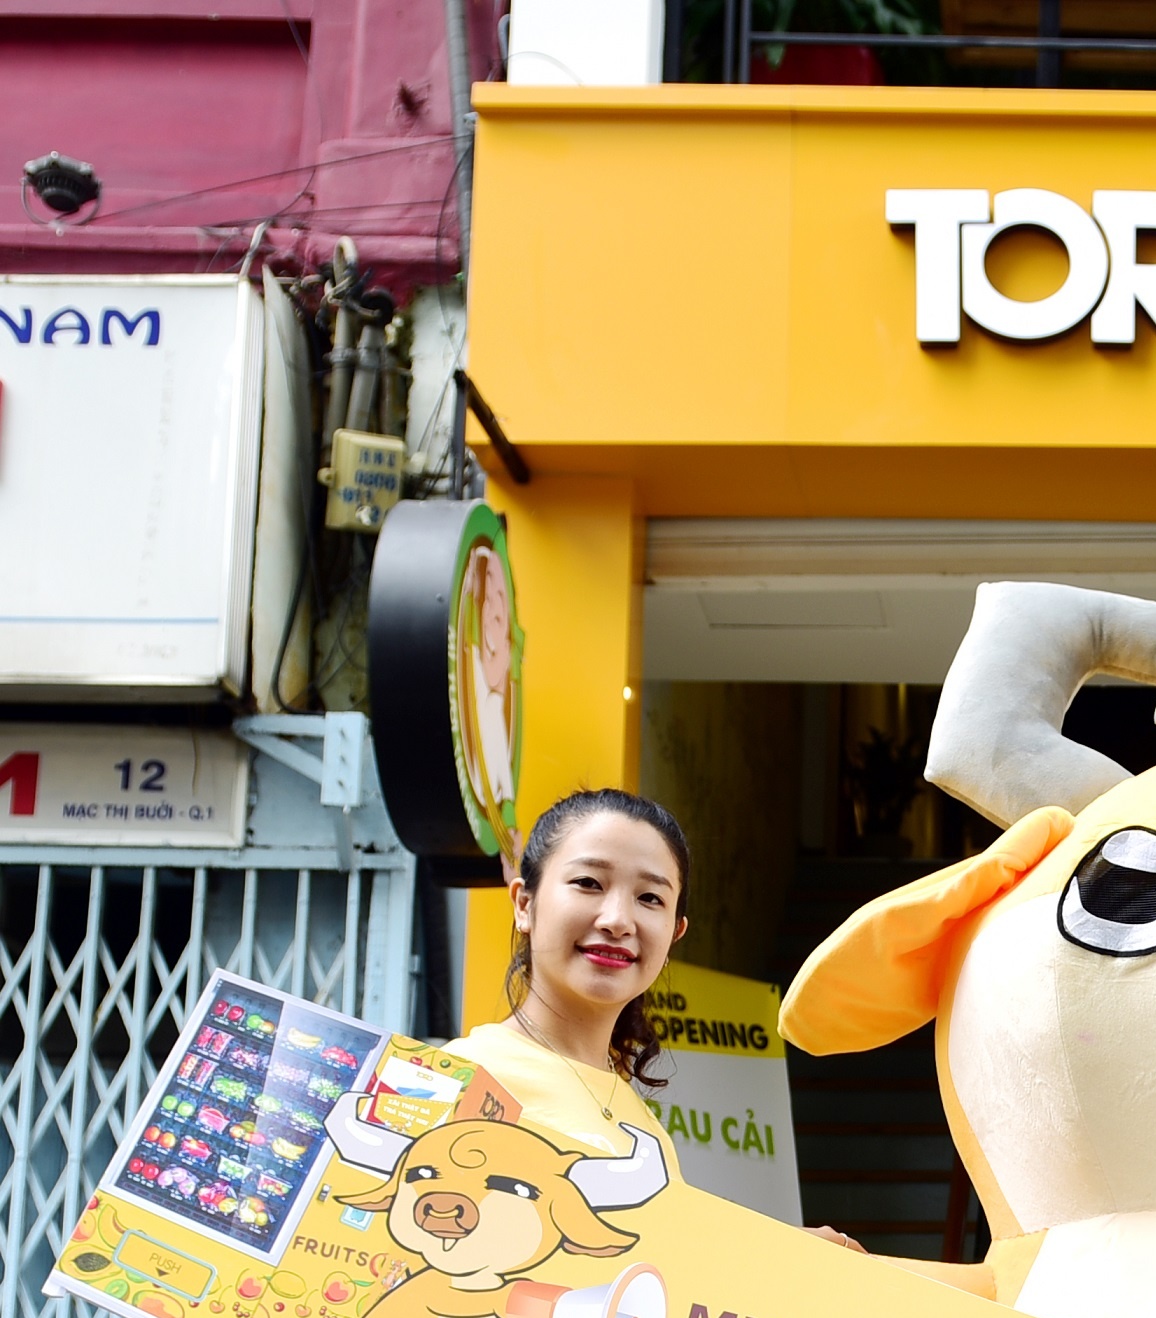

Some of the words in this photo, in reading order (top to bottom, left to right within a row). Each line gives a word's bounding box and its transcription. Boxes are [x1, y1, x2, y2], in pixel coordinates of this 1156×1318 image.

[114, 759, 166, 791] 12
[650, 1014, 769, 1050] OPENING
[721, 1108, 775, 1156] CẢI
[149, 1252, 182, 1274] PUSH
[292, 1235, 370, 1267] FRUITS
